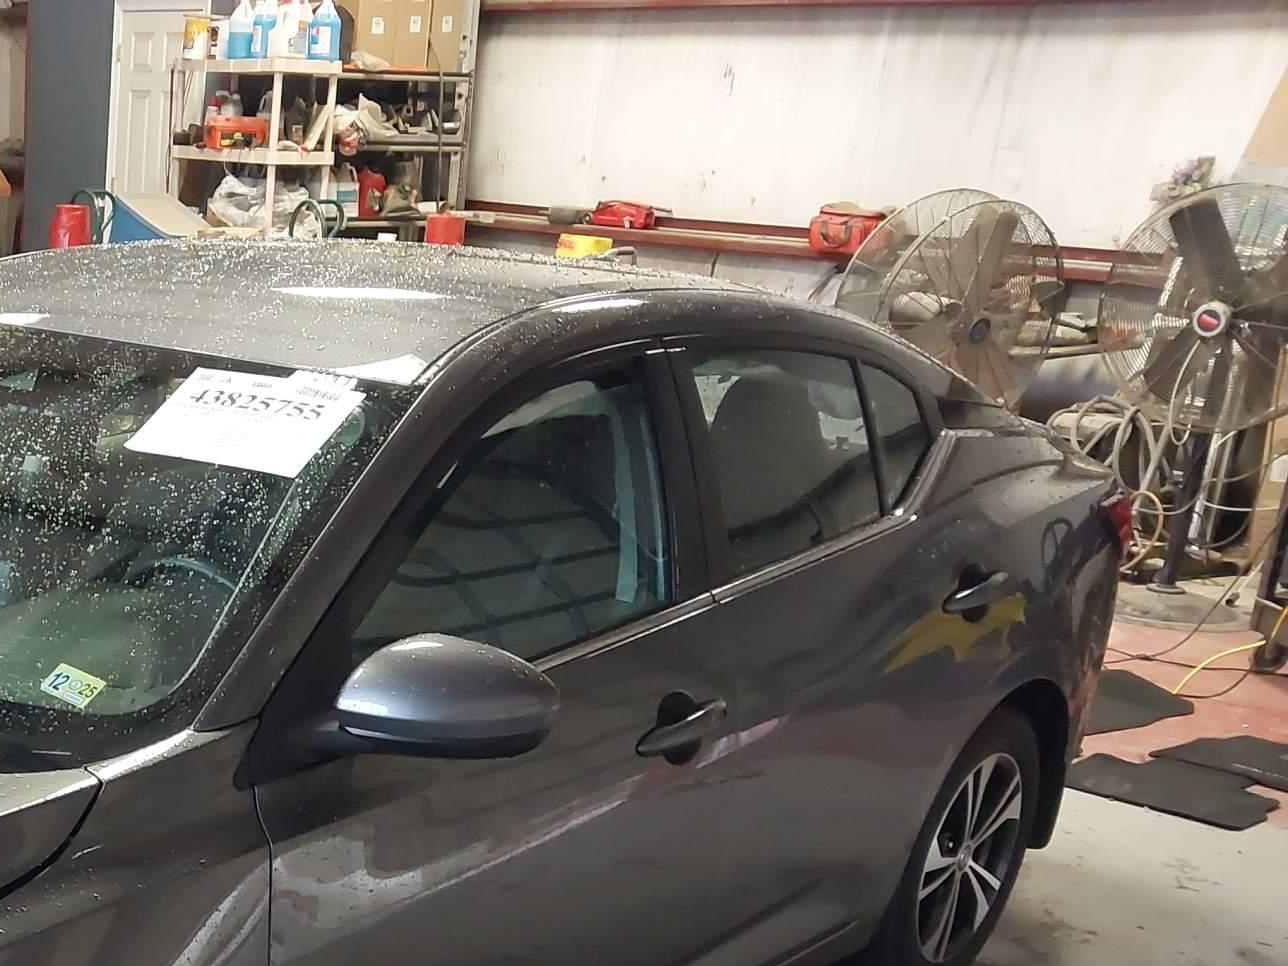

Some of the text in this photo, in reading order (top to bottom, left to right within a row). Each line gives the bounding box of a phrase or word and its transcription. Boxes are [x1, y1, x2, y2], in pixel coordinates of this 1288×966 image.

[190, 389, 325, 420] 43825755
[48, 671, 70, 691] 12
[77, 683, 98, 698] 25
